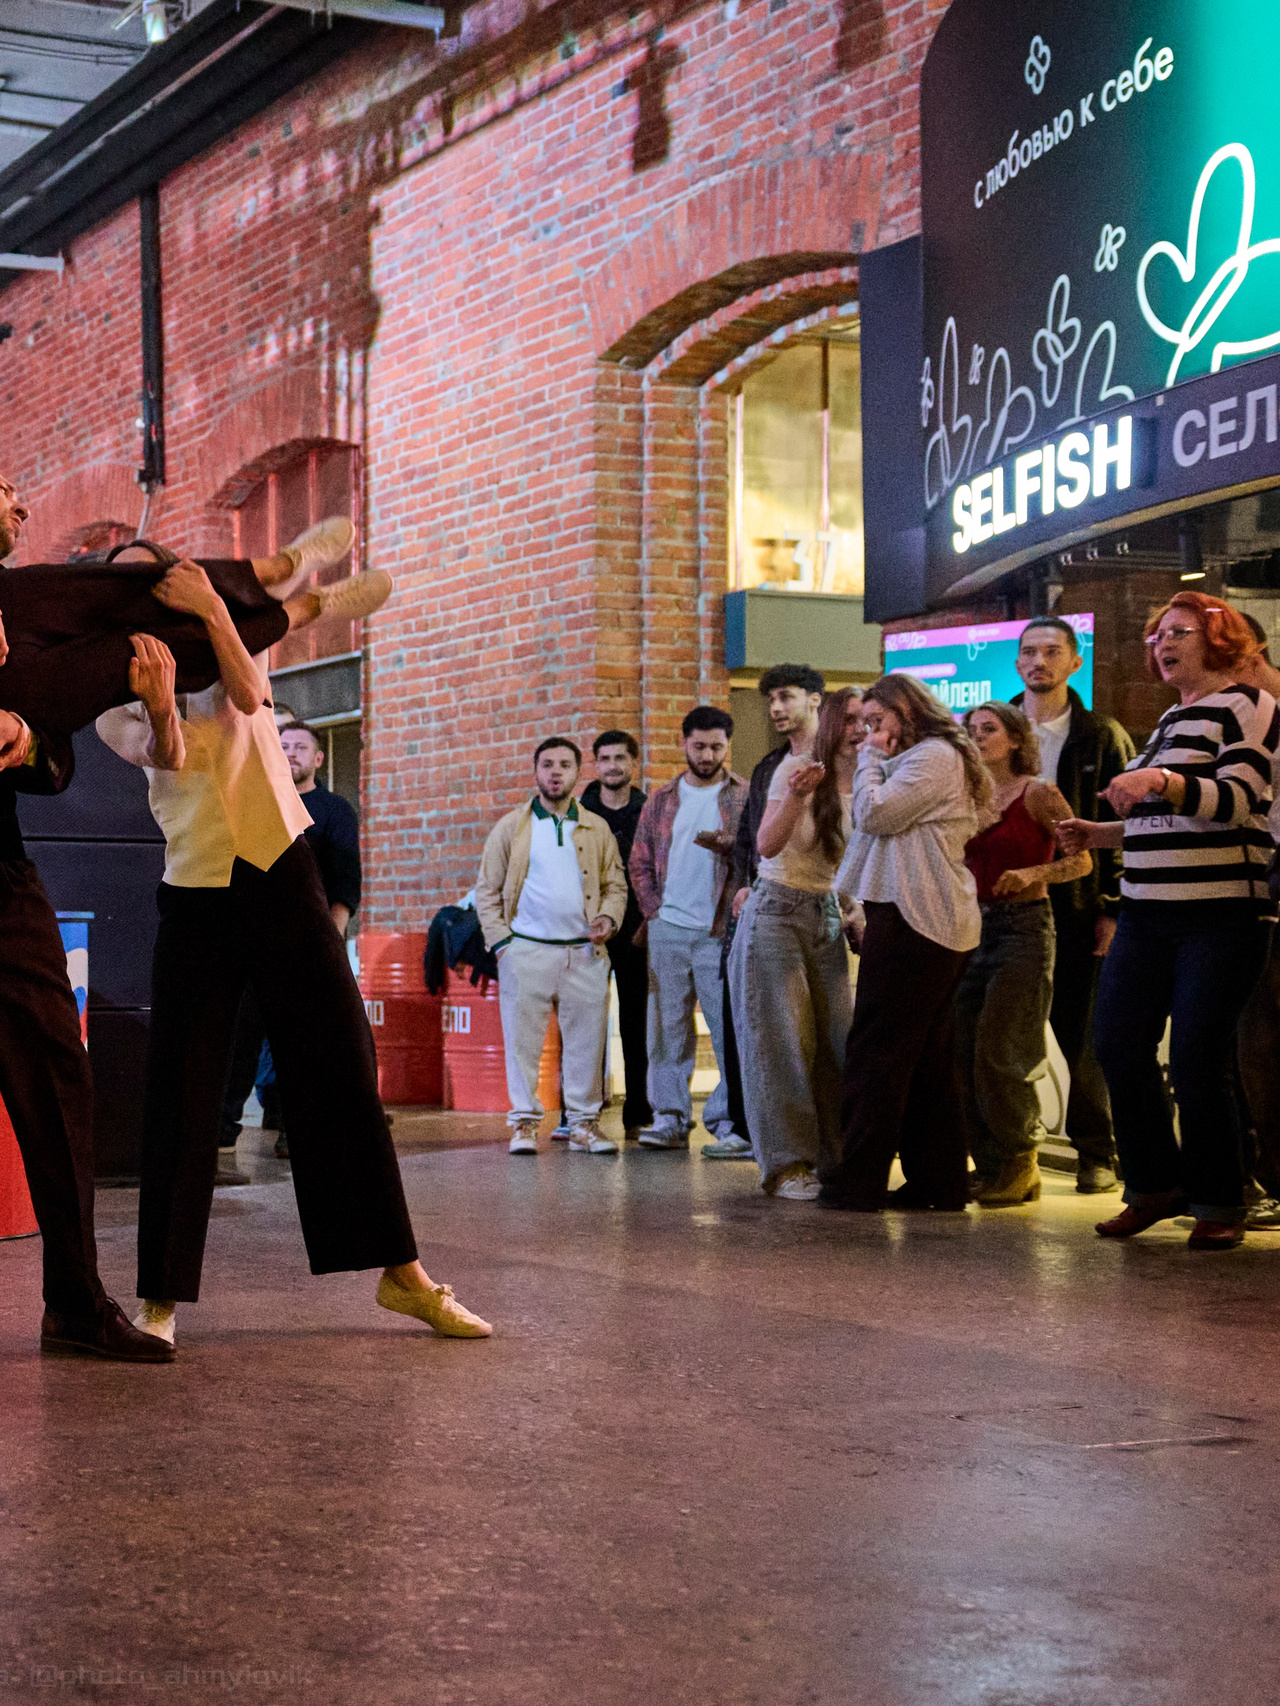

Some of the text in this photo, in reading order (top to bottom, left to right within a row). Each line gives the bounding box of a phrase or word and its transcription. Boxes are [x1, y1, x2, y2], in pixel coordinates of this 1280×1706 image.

[974, 36, 1175, 209] с любовью к себе
[951, 414, 1133, 555] SELFISH
